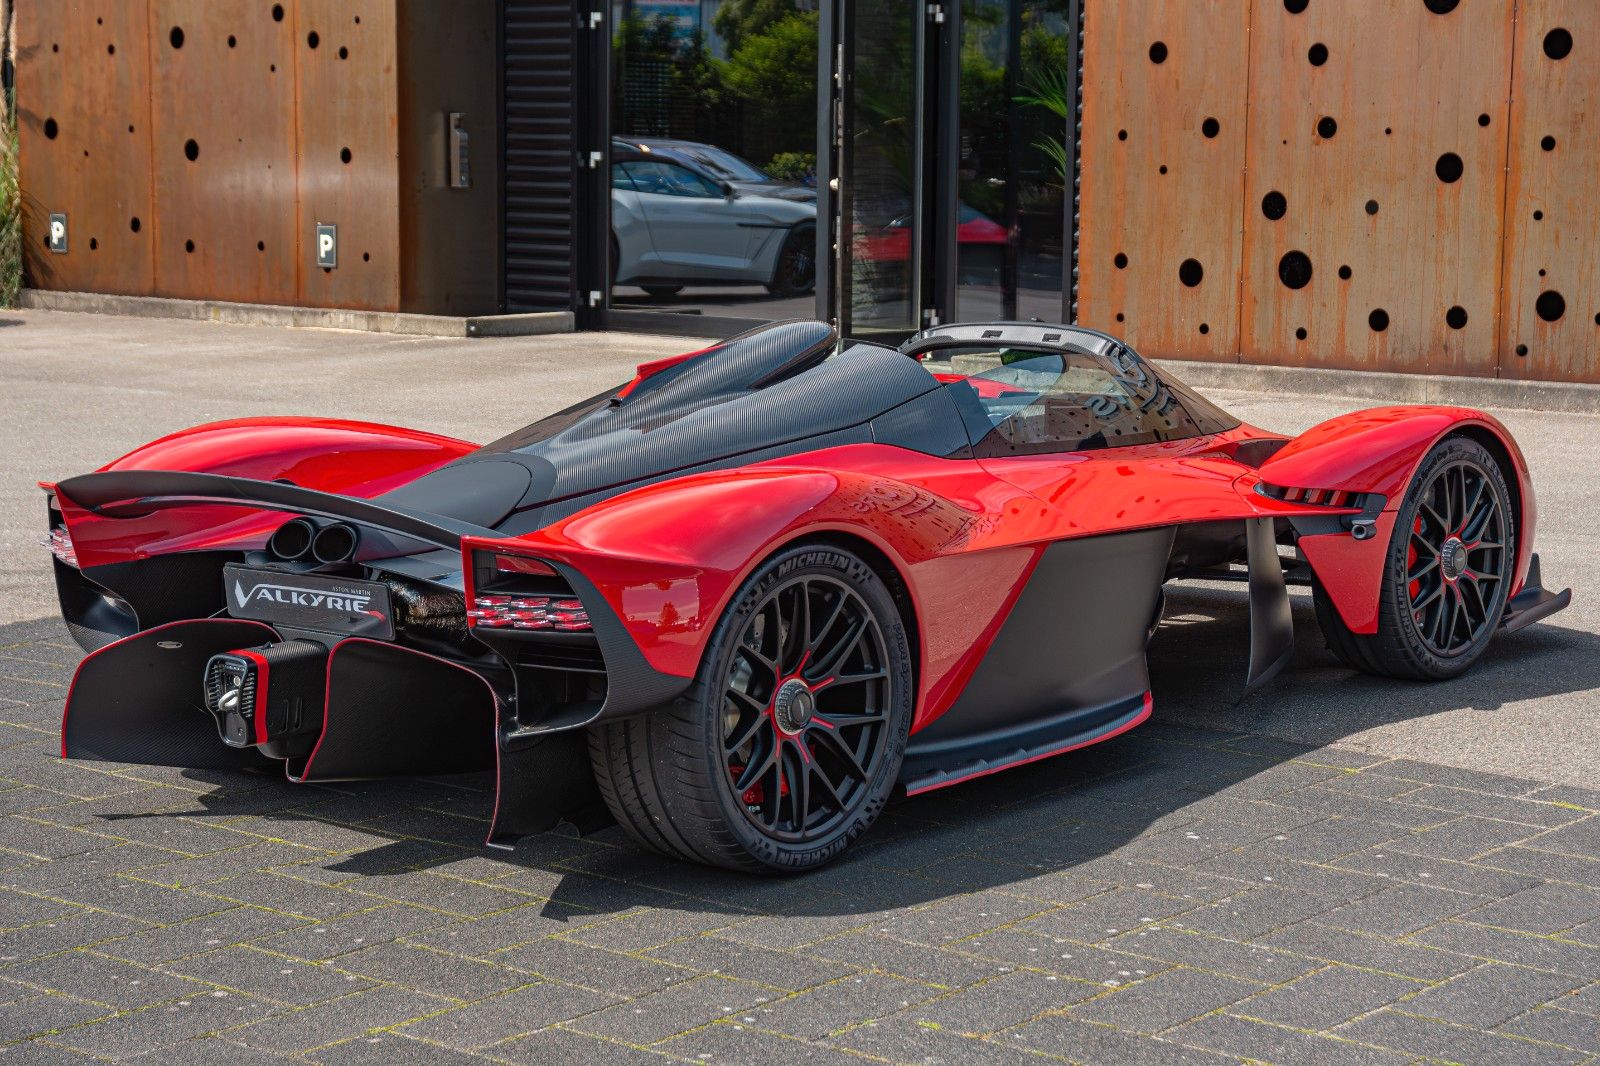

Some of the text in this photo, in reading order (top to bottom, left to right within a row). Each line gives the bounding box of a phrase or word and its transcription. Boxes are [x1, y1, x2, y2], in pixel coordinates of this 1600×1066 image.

[51, 221, 65, 245] P
[319, 234, 334, 258] P
[779, 552, 850, 577] MICHELIN
[234, 579, 371, 614] VALKYRIE
[332, 586, 371, 596] ASTON MARTIN
[775, 835, 848, 865] MICHELIN
